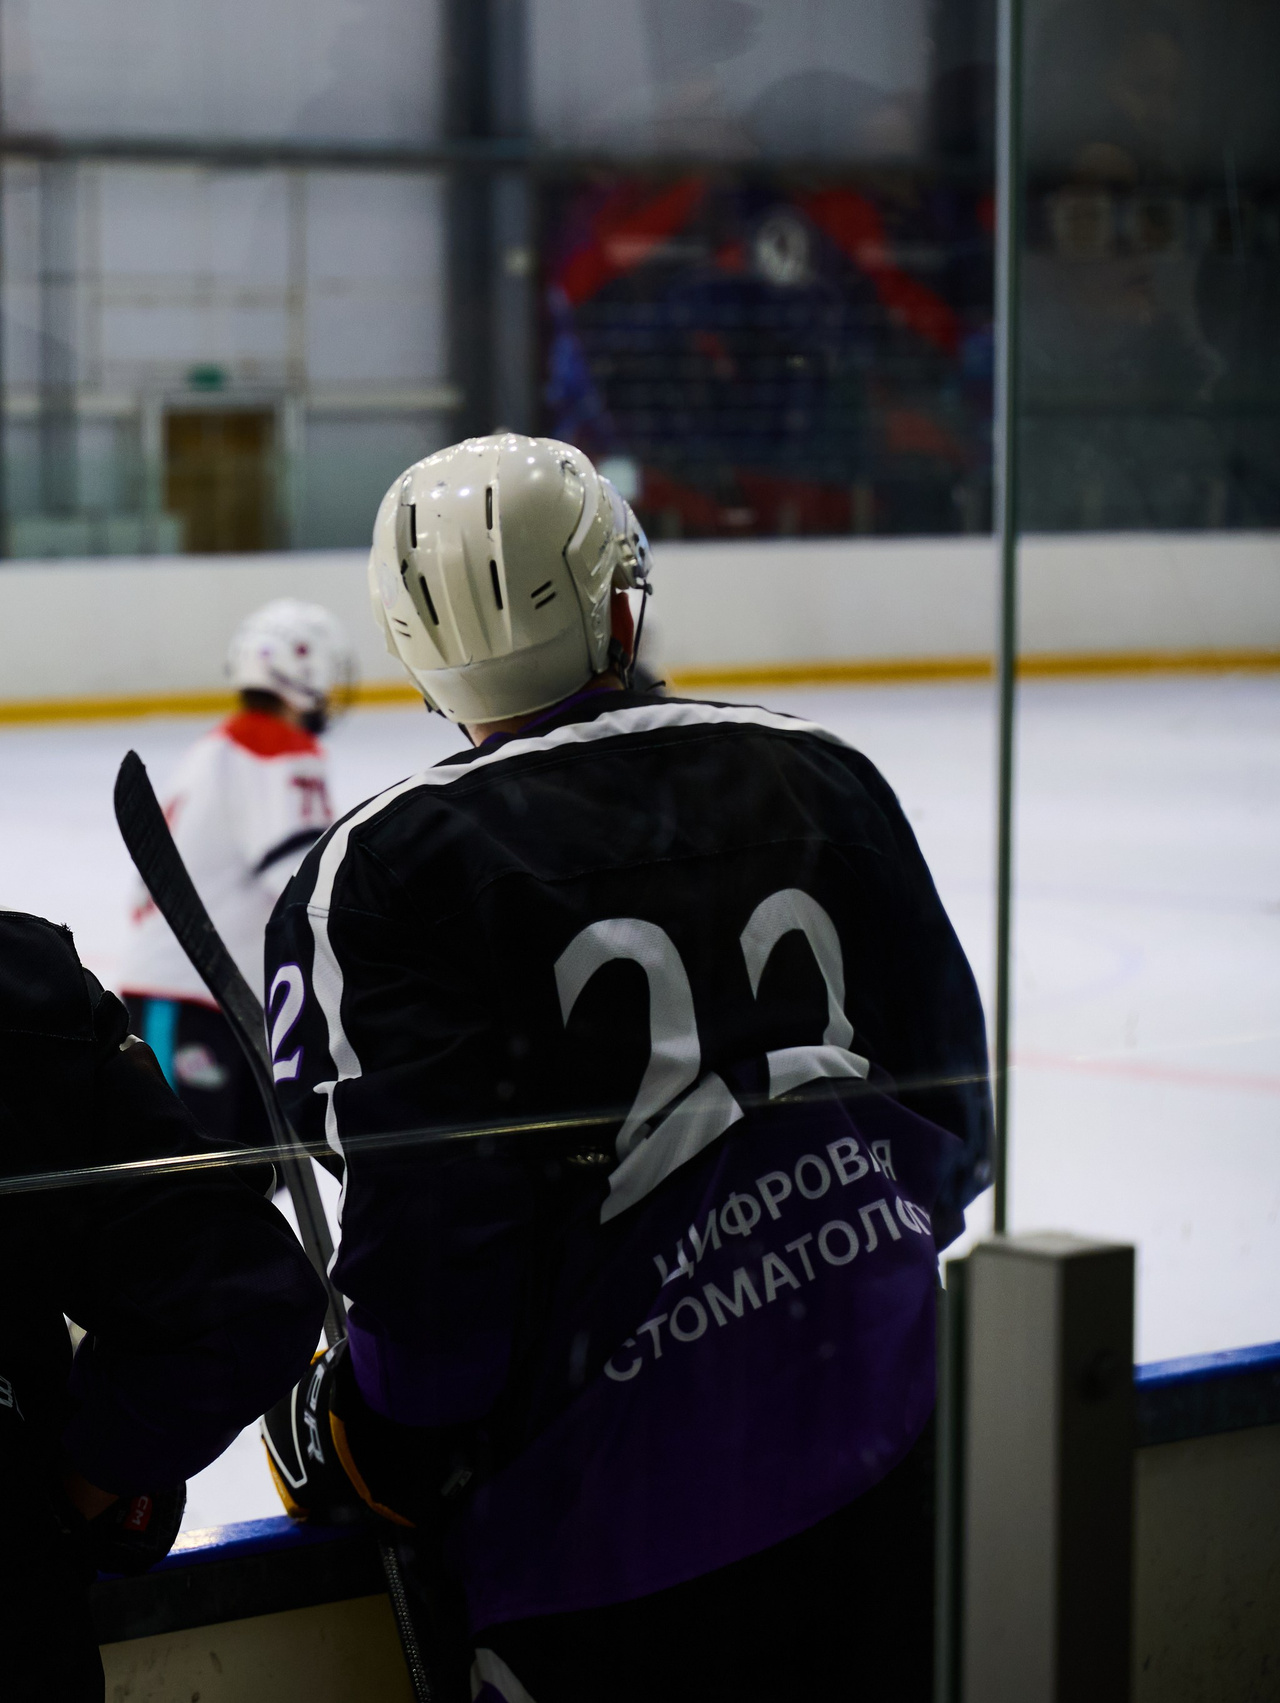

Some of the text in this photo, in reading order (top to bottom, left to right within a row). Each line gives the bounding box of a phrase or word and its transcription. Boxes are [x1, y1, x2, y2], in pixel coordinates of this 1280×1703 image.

[266, 961, 304, 1085] 2
[554, 888, 870, 1225] 22
[653, 1136, 897, 1286] ЦИФРОВЯ
